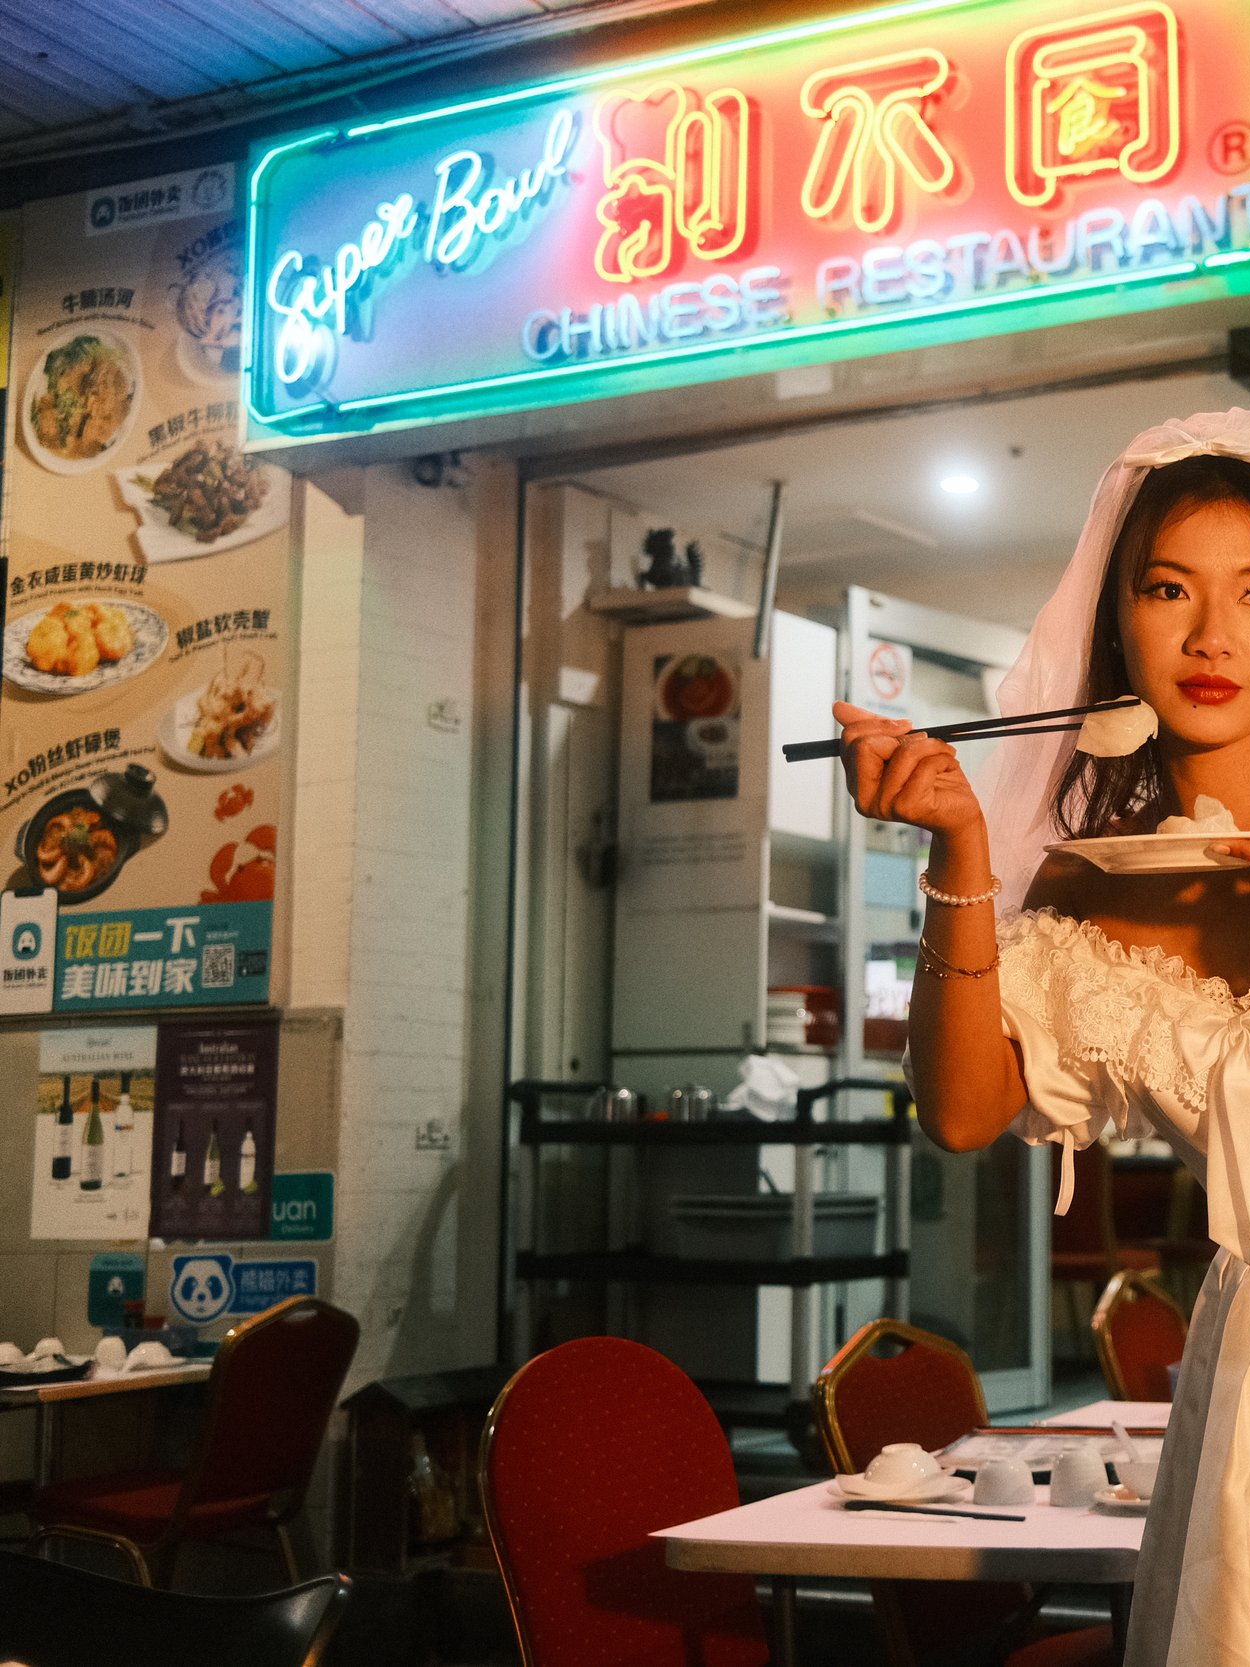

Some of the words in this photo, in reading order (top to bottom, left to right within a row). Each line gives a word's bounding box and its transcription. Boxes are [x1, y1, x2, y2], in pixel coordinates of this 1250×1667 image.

[268, 192, 414, 383] Super
[424, 109, 574, 264] Bowl
[522, 265, 786, 364] CHINESE
[64, 916, 200, 960] 饭团一下
[61, 958, 198, 1001] 美味到家
